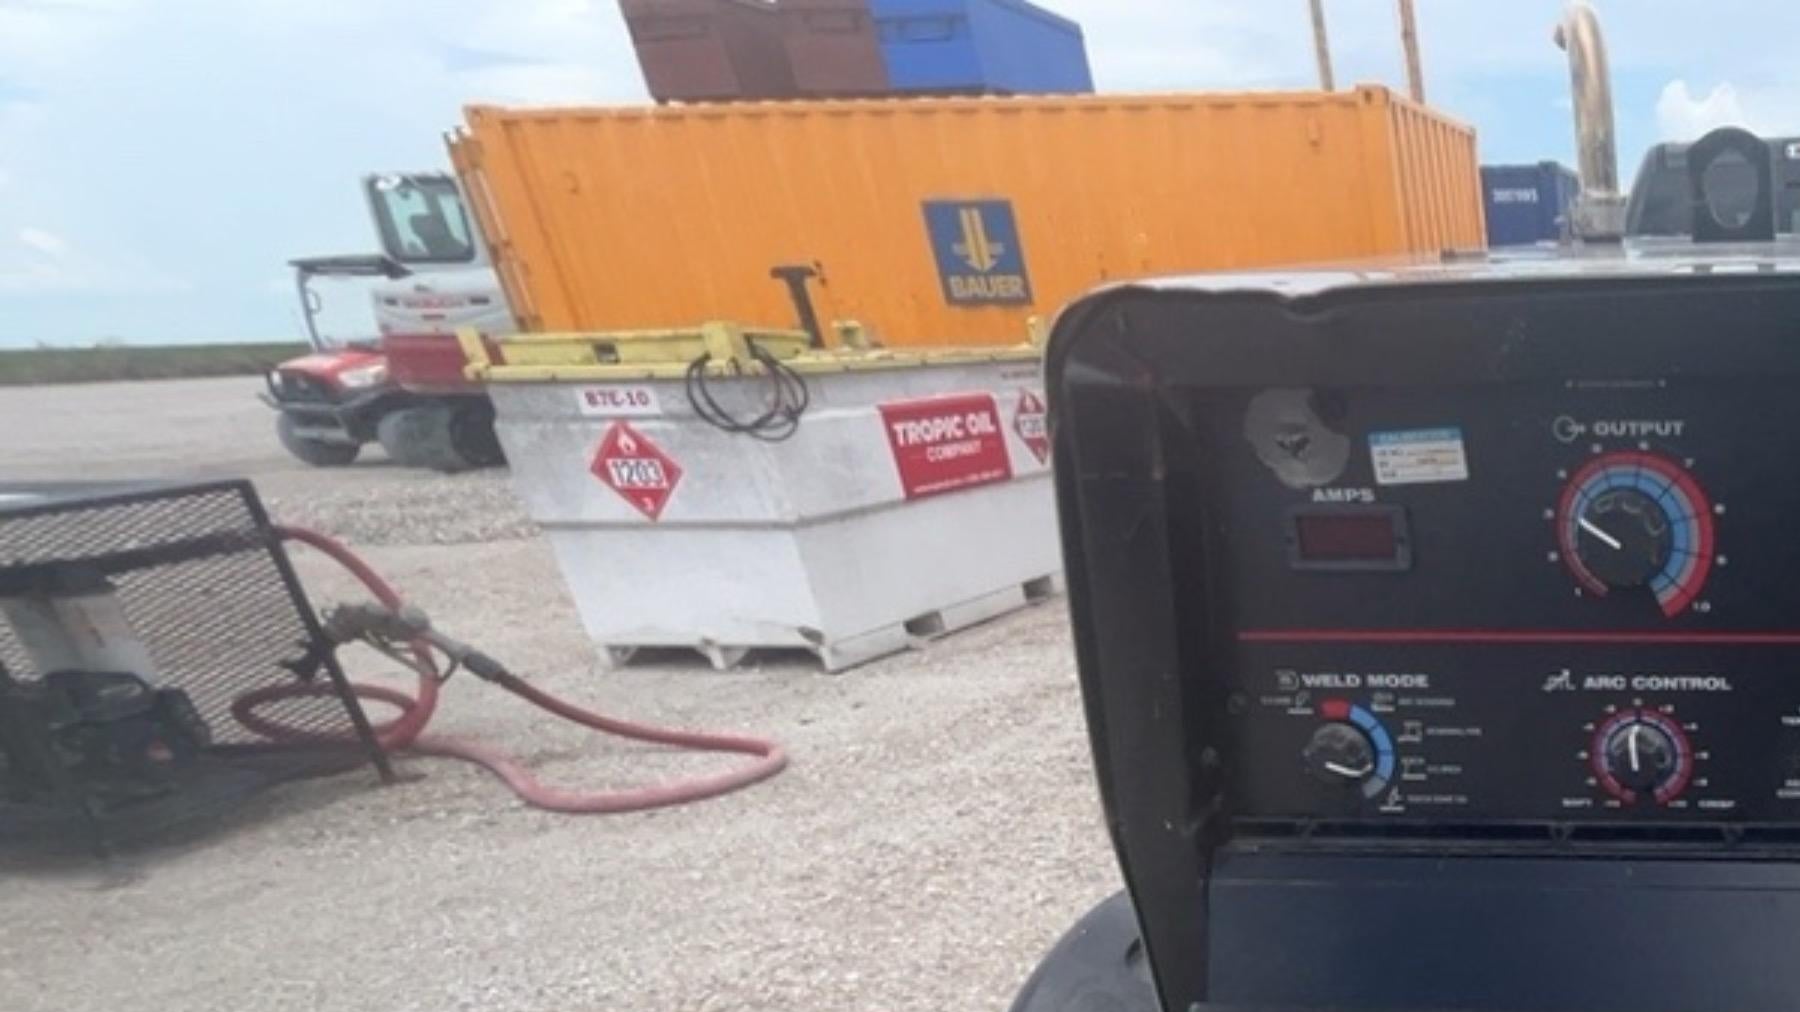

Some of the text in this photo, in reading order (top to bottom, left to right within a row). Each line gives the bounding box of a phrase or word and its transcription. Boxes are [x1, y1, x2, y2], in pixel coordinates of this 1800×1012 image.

[948, 275, 1025, 298] BAUER
[894, 415, 965, 446] TROPIC
[966, 412, 996, 435] OIL
[1593, 419, 1685, 437] OUTPUT
[1312, 488, 1375, 503] AMPS
[1302, 674, 1429, 688] WELD MODE
[1583, 677, 1733, 691] ARC CONTROL
